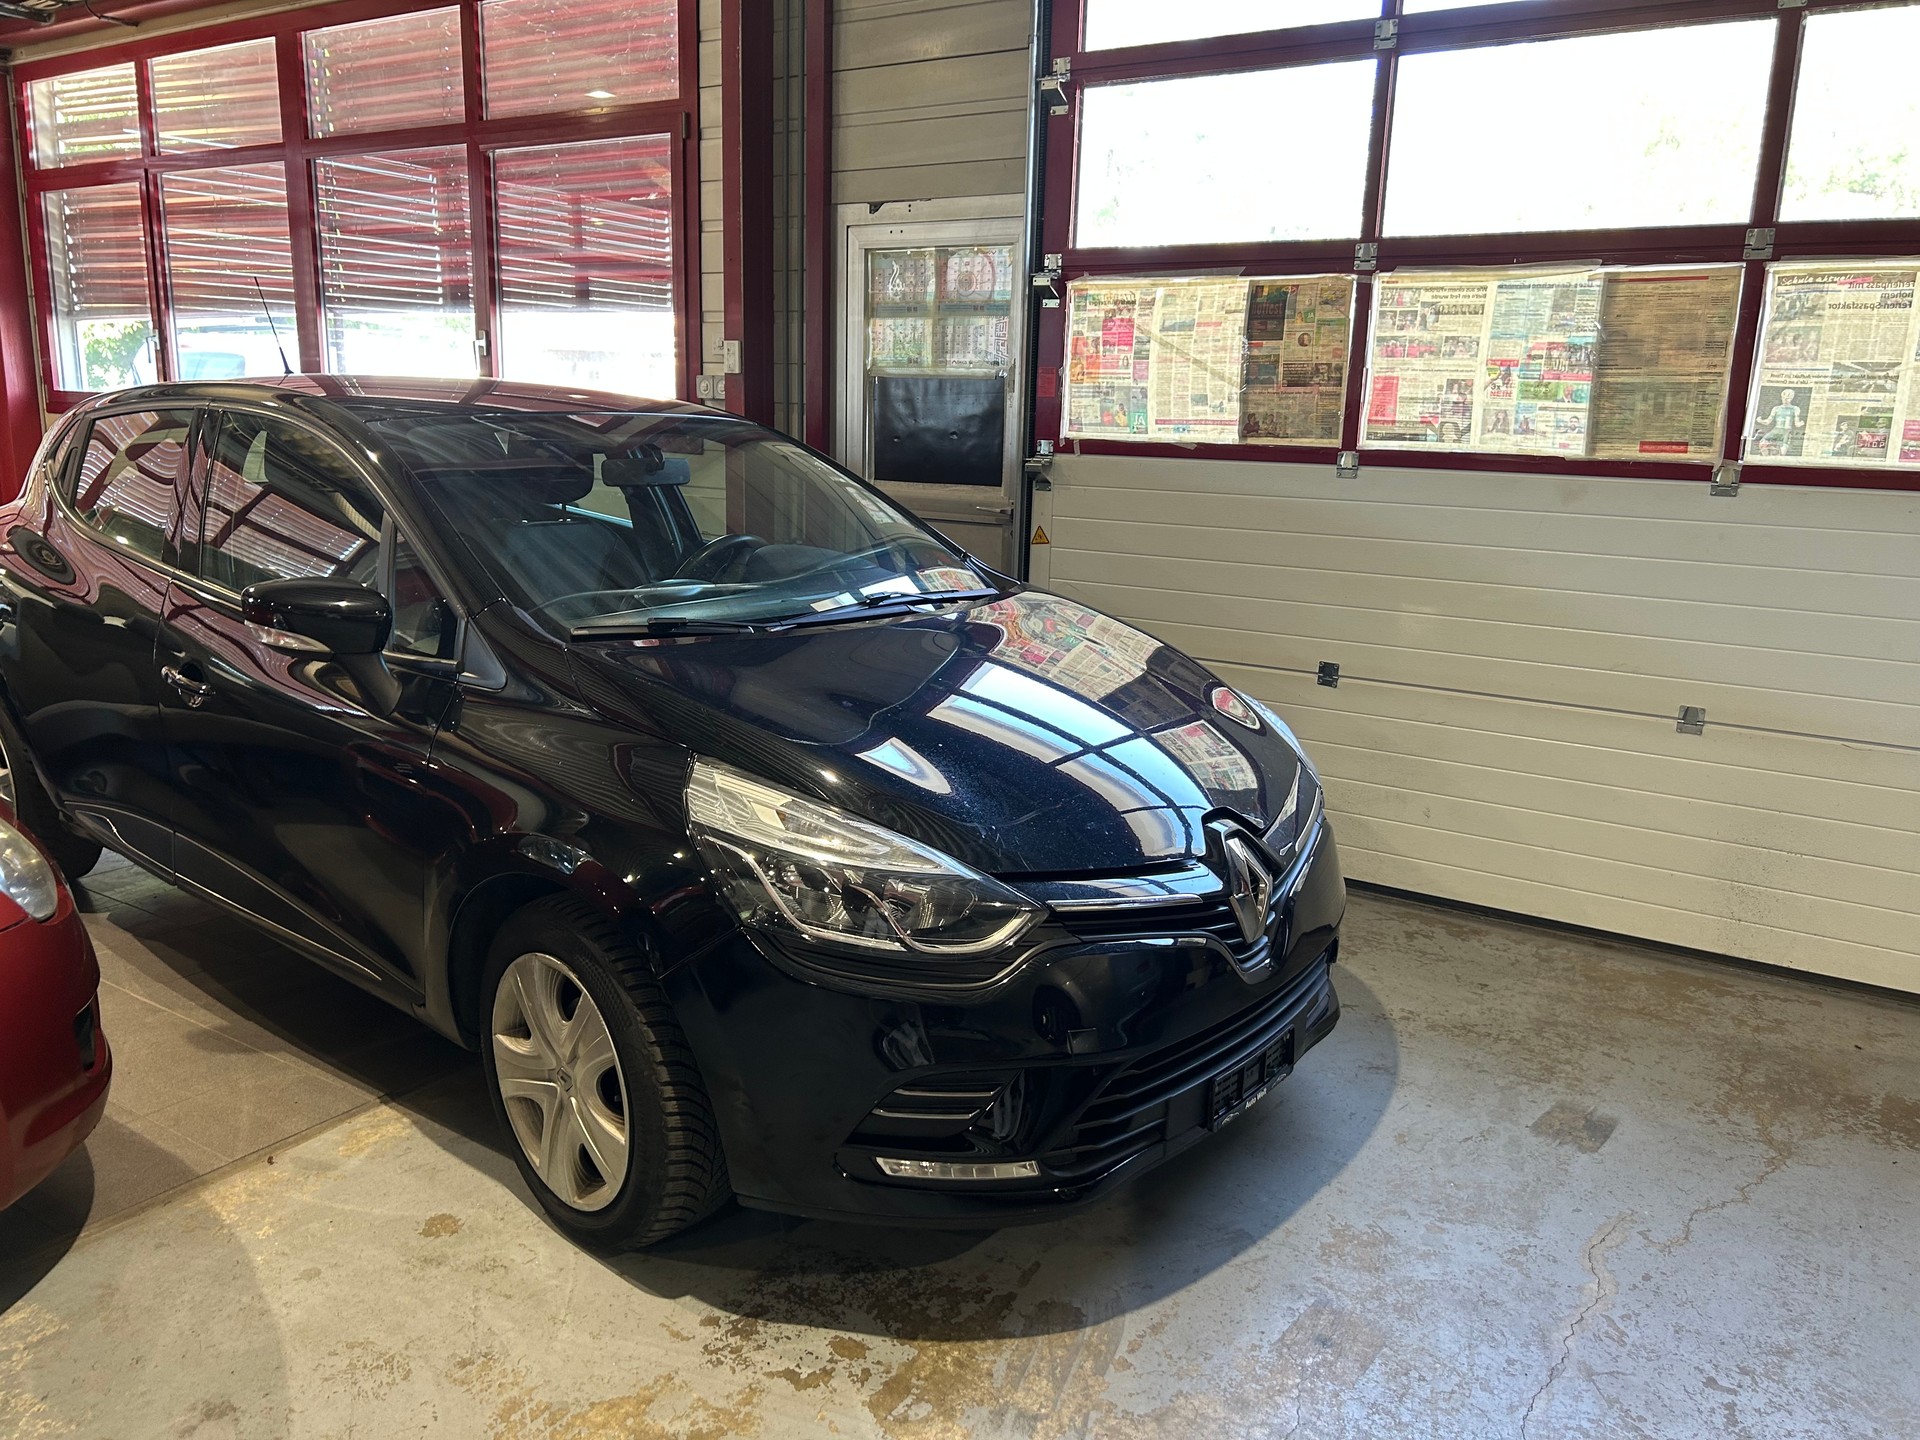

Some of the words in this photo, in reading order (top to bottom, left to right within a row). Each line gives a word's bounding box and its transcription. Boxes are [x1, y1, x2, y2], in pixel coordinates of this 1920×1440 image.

[1780, 275, 1813, 286] Schule
[1815, 273, 1854, 283] aktuell
[1244, 1096, 1257, 1110] Auto
